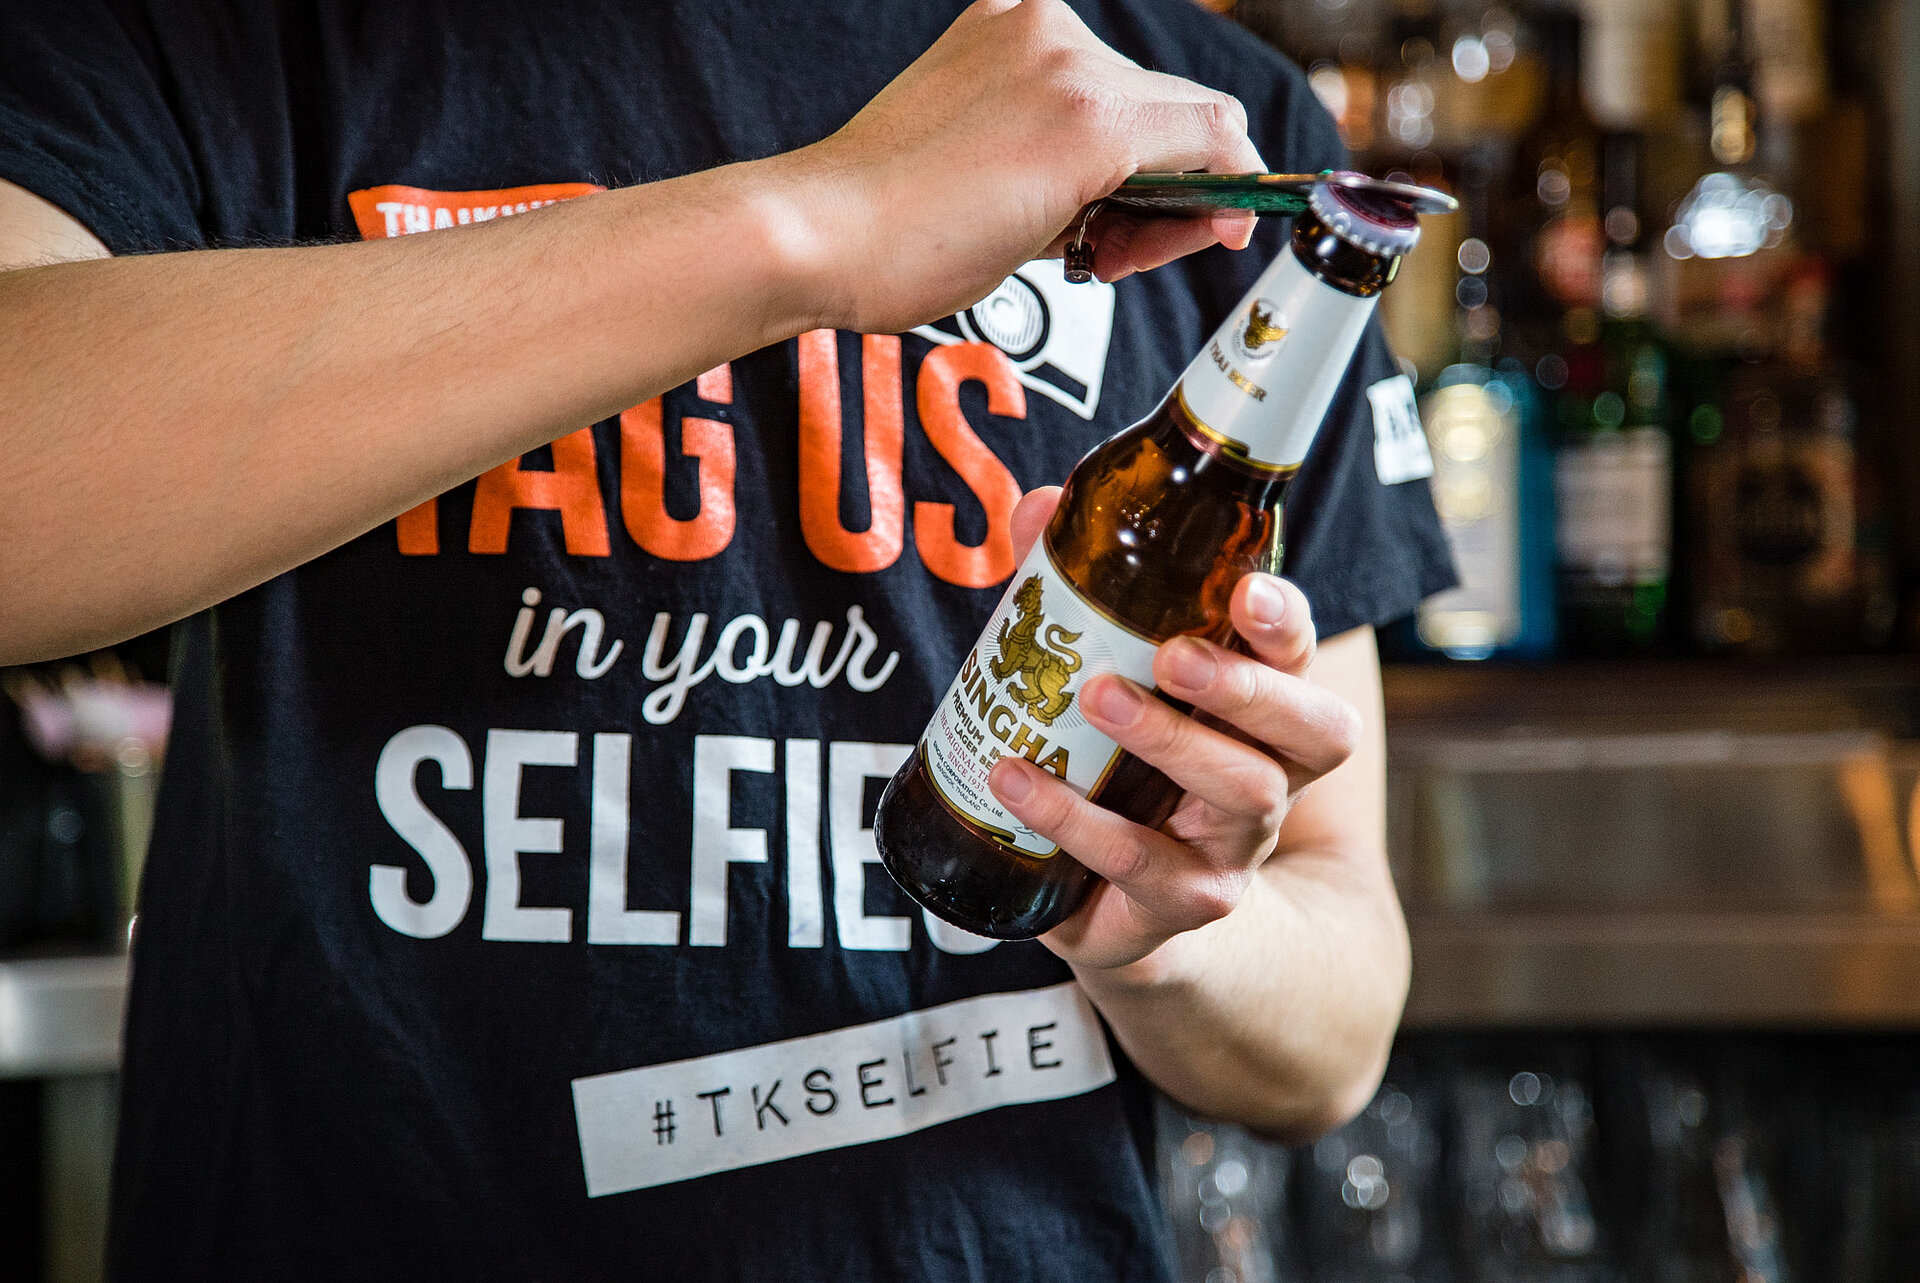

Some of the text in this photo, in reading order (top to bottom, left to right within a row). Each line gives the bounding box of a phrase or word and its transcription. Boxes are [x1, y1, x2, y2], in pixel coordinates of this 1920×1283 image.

[1210, 340, 1229, 372] THAI
[1228, 368, 1267, 401] BEER
[799, 328, 1027, 590] US
[504, 587, 900, 726] in your
[953, 688, 985, 745] PREMIUM
[961, 648, 1070, 780] SINGHA
[944, 727, 977, 773] ORIGINAL
[947, 751, 985, 793] SINCE 1933
[954, 723, 994, 771] LAGER BE
[943, 761, 979, 800] CORPORATION
[955, 786, 981, 811] THAILAND
[369, 725, 1001, 955] SELFIE
[654, 1022, 1062, 1146] #TKSELFIE
